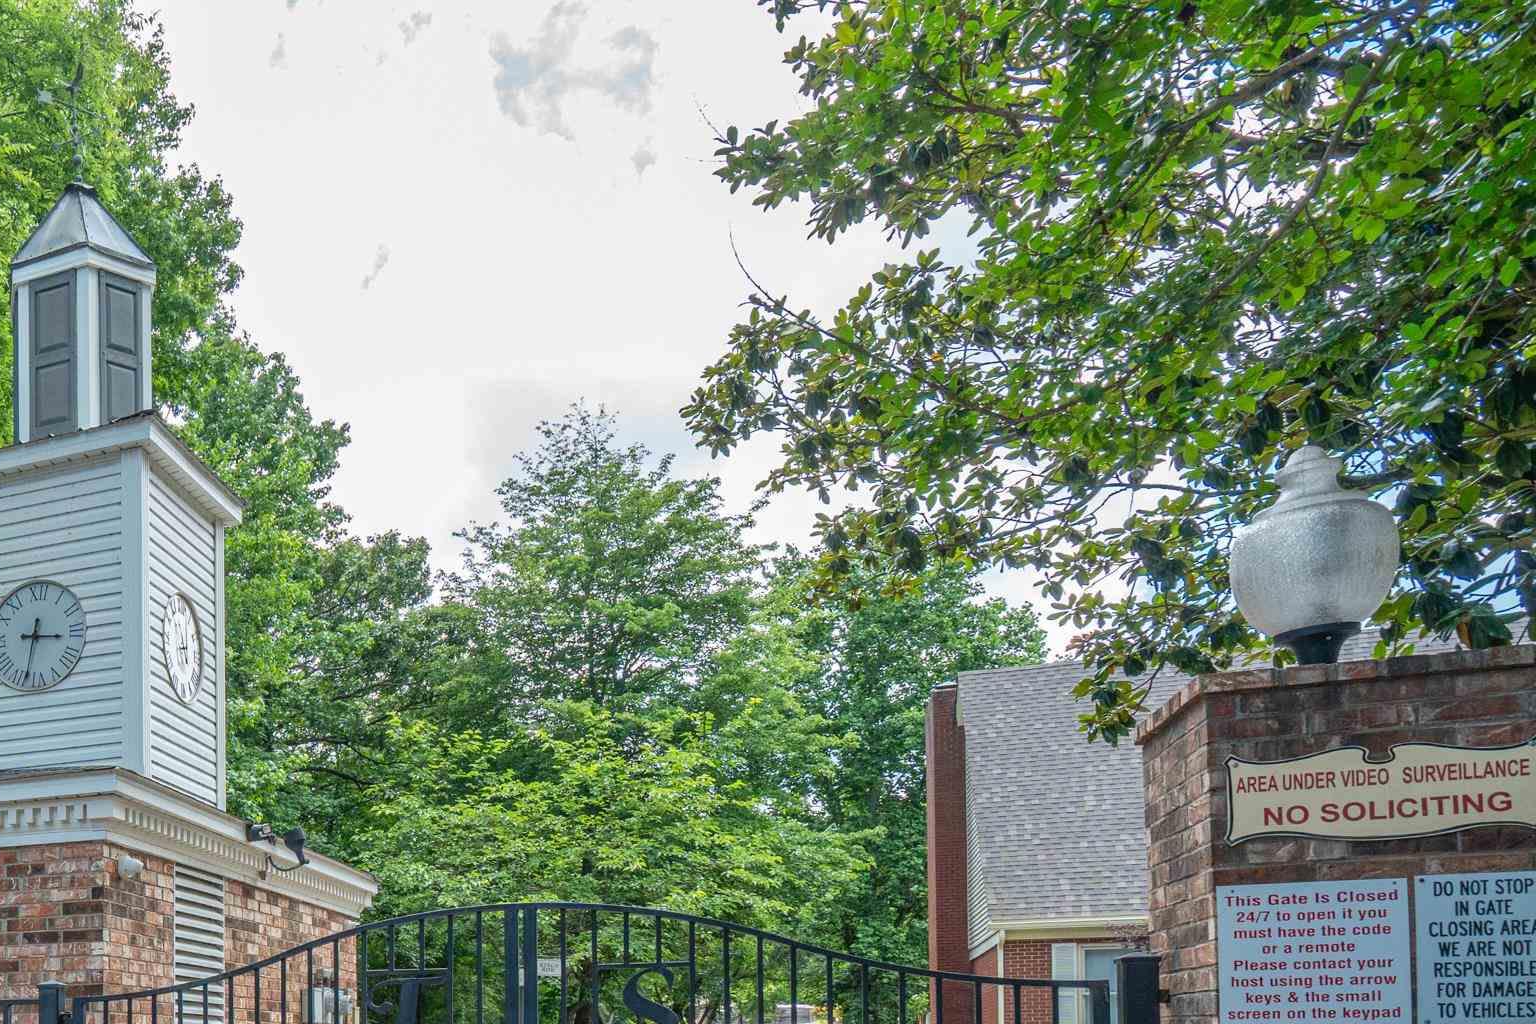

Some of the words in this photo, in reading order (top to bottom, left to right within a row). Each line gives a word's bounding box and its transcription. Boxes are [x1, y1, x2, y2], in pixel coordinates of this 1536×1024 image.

[1236, 775, 1279, 794] AREA
[1282, 771, 1336, 791] UNDER
[1340, 768, 1390, 788] VIDEO
[1402, 758, 1531, 784] SURVEILLANCE
[1263, 805, 1310, 826] NO
[1320, 791, 1513, 823] SOLICITING
[1433, 881, 1454, 896] DO
[1460, 880, 1489, 895] NOT
[1495, 879, 1534, 894] STOP
[1224, 895, 1261, 907] This
[1268, 893, 1308, 905] Gate
[1315, 892, 1330, 903] Is
[1336, 889, 1399, 903] Closed
[1236, 911, 1270, 923] 24/7
[1276, 911, 1291, 922] to
[1297, 909, 1336, 923] open
[1342, 908, 1353, 919] it
[1358, 908, 1388, 921] you
[1455, 901, 1469, 916] IN
[1475, 899, 1514, 915] GATE
[1233, 927, 1273, 939] must
[1278, 925, 1316, 938] have
[1321, 924, 1348, 936] the
[1352, 924, 1392, 935] code
[1429, 920, 1494, 937] CLOSING
[1262, 944, 1279, 955] or
[1284, 944, 1292, 954] a
[1298, 941, 1356, 953] remote
[1438, 941, 1460, 957] WE
[1466, 941, 1496, 956] ARE
[1502, 940, 1532, 956] NOT
[1233, 960, 1288, 971] Please
[1293, 958, 1352, 970] contact
[1357, 958, 1394, 971] your
[1433, 961, 1536, 978] RESPONSIBLE
[1231, 976, 1264, 988] host
[1270, 976, 1313, 988] using
[1319, 975, 1344, 986] the
[1349, 975, 1398, 985] arrow
[1437, 982, 1466, 998] FOR
[1472, 981, 1536, 998] DAMAGE
[1245, 992, 1281, 1005] keys
[1287, 991, 1299, 1003] &
[1305, 991, 1330, 1003] the
[1335, 990, 1382, 1002] small
[1228, 1009, 1281, 1020] screen
[1287, 1009, 1306, 1019] on
[1312, 1008, 1337, 1019] the
[1343, 1006, 1401, 1021] keypad
[1438, 1003, 1456, 1018] TO
[1462, 1002, 1536, 1018] VEHICLES
